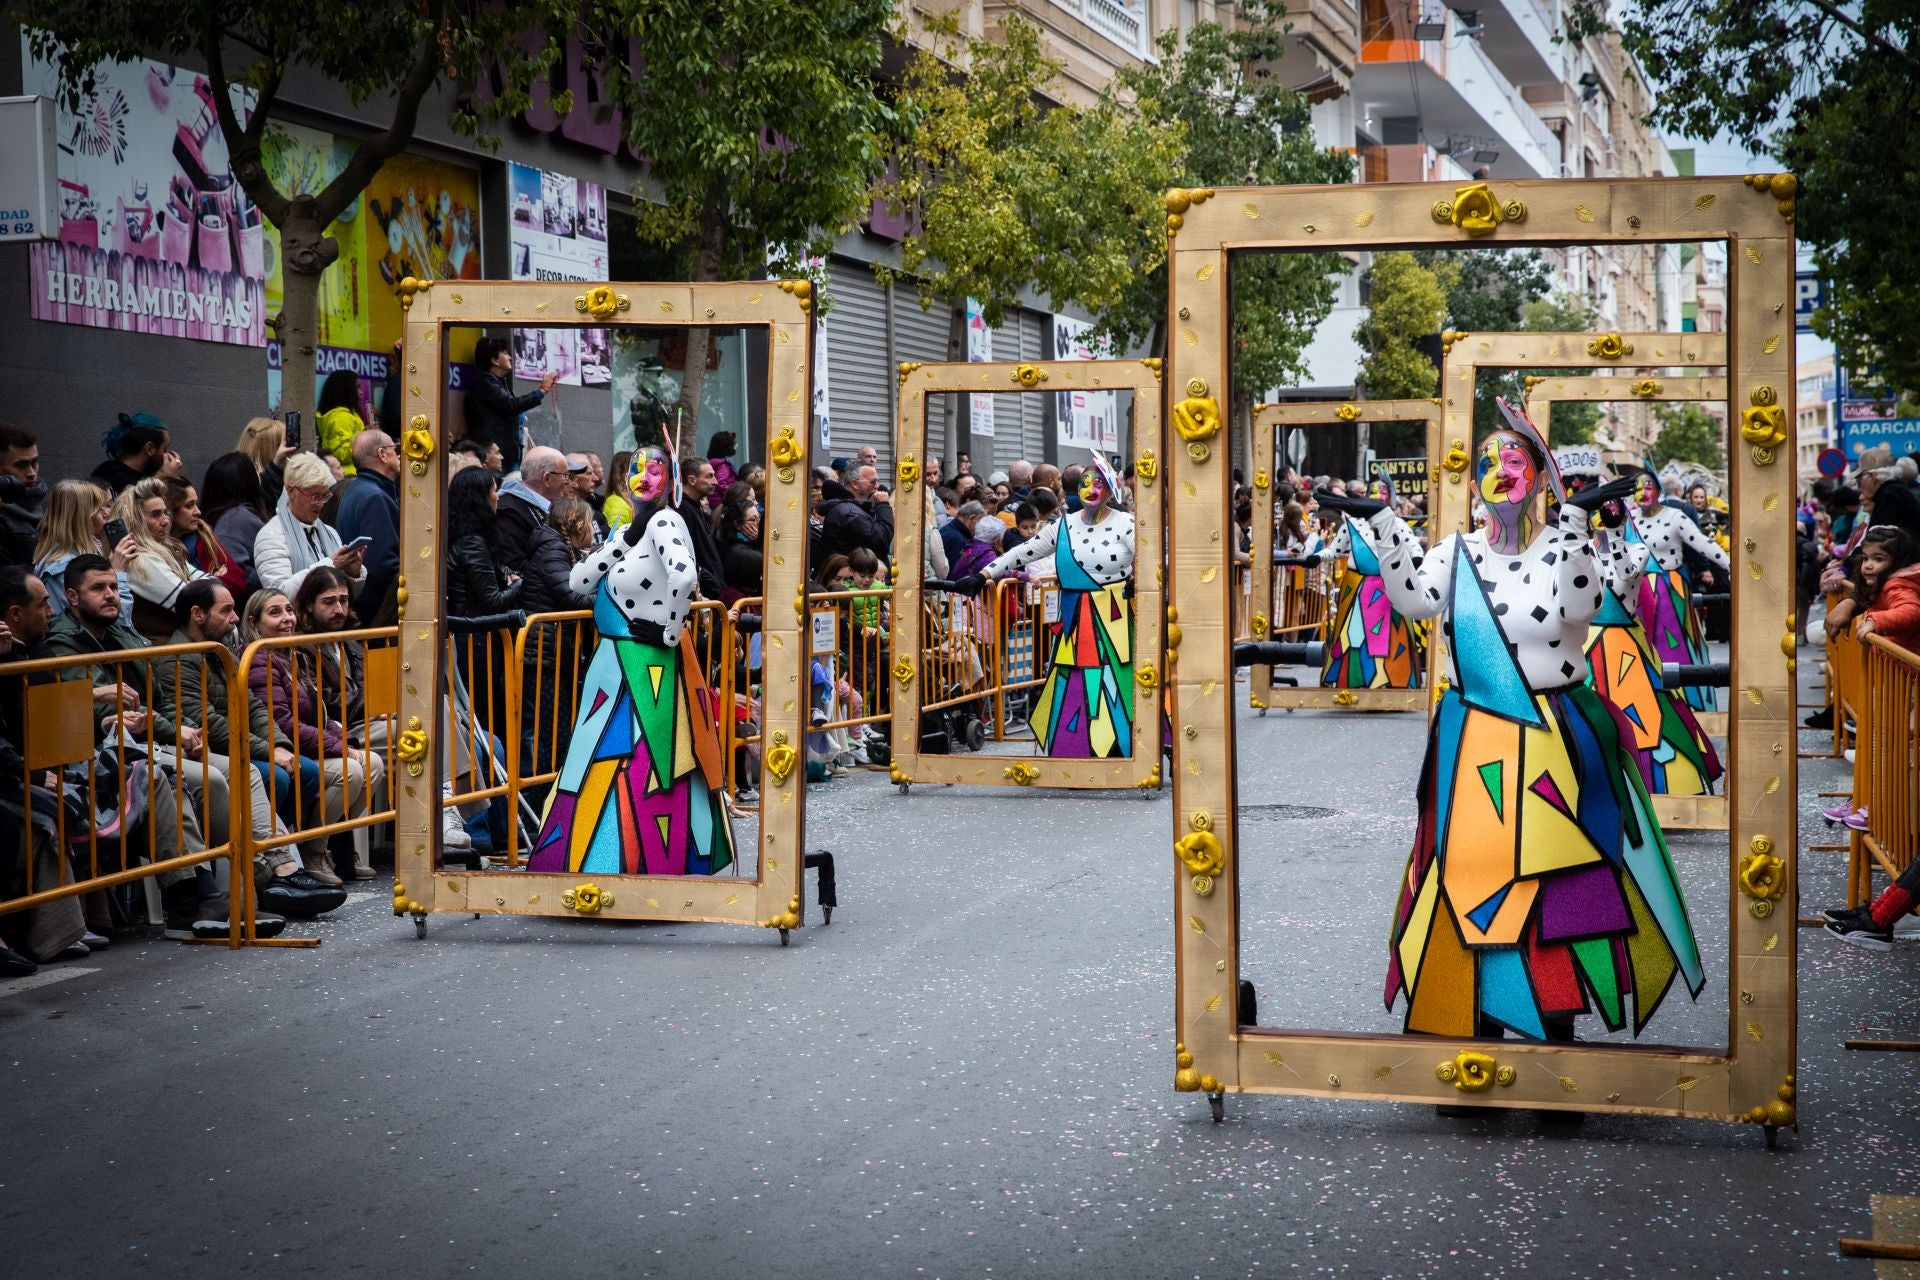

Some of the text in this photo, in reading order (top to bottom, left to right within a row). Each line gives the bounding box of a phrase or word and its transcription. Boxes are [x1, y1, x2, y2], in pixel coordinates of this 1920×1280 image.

[14, 223, 34, 234] 62
[47, 270, 251, 329] HERRAMIENTAS
[1796, 279, 1819, 310] P
